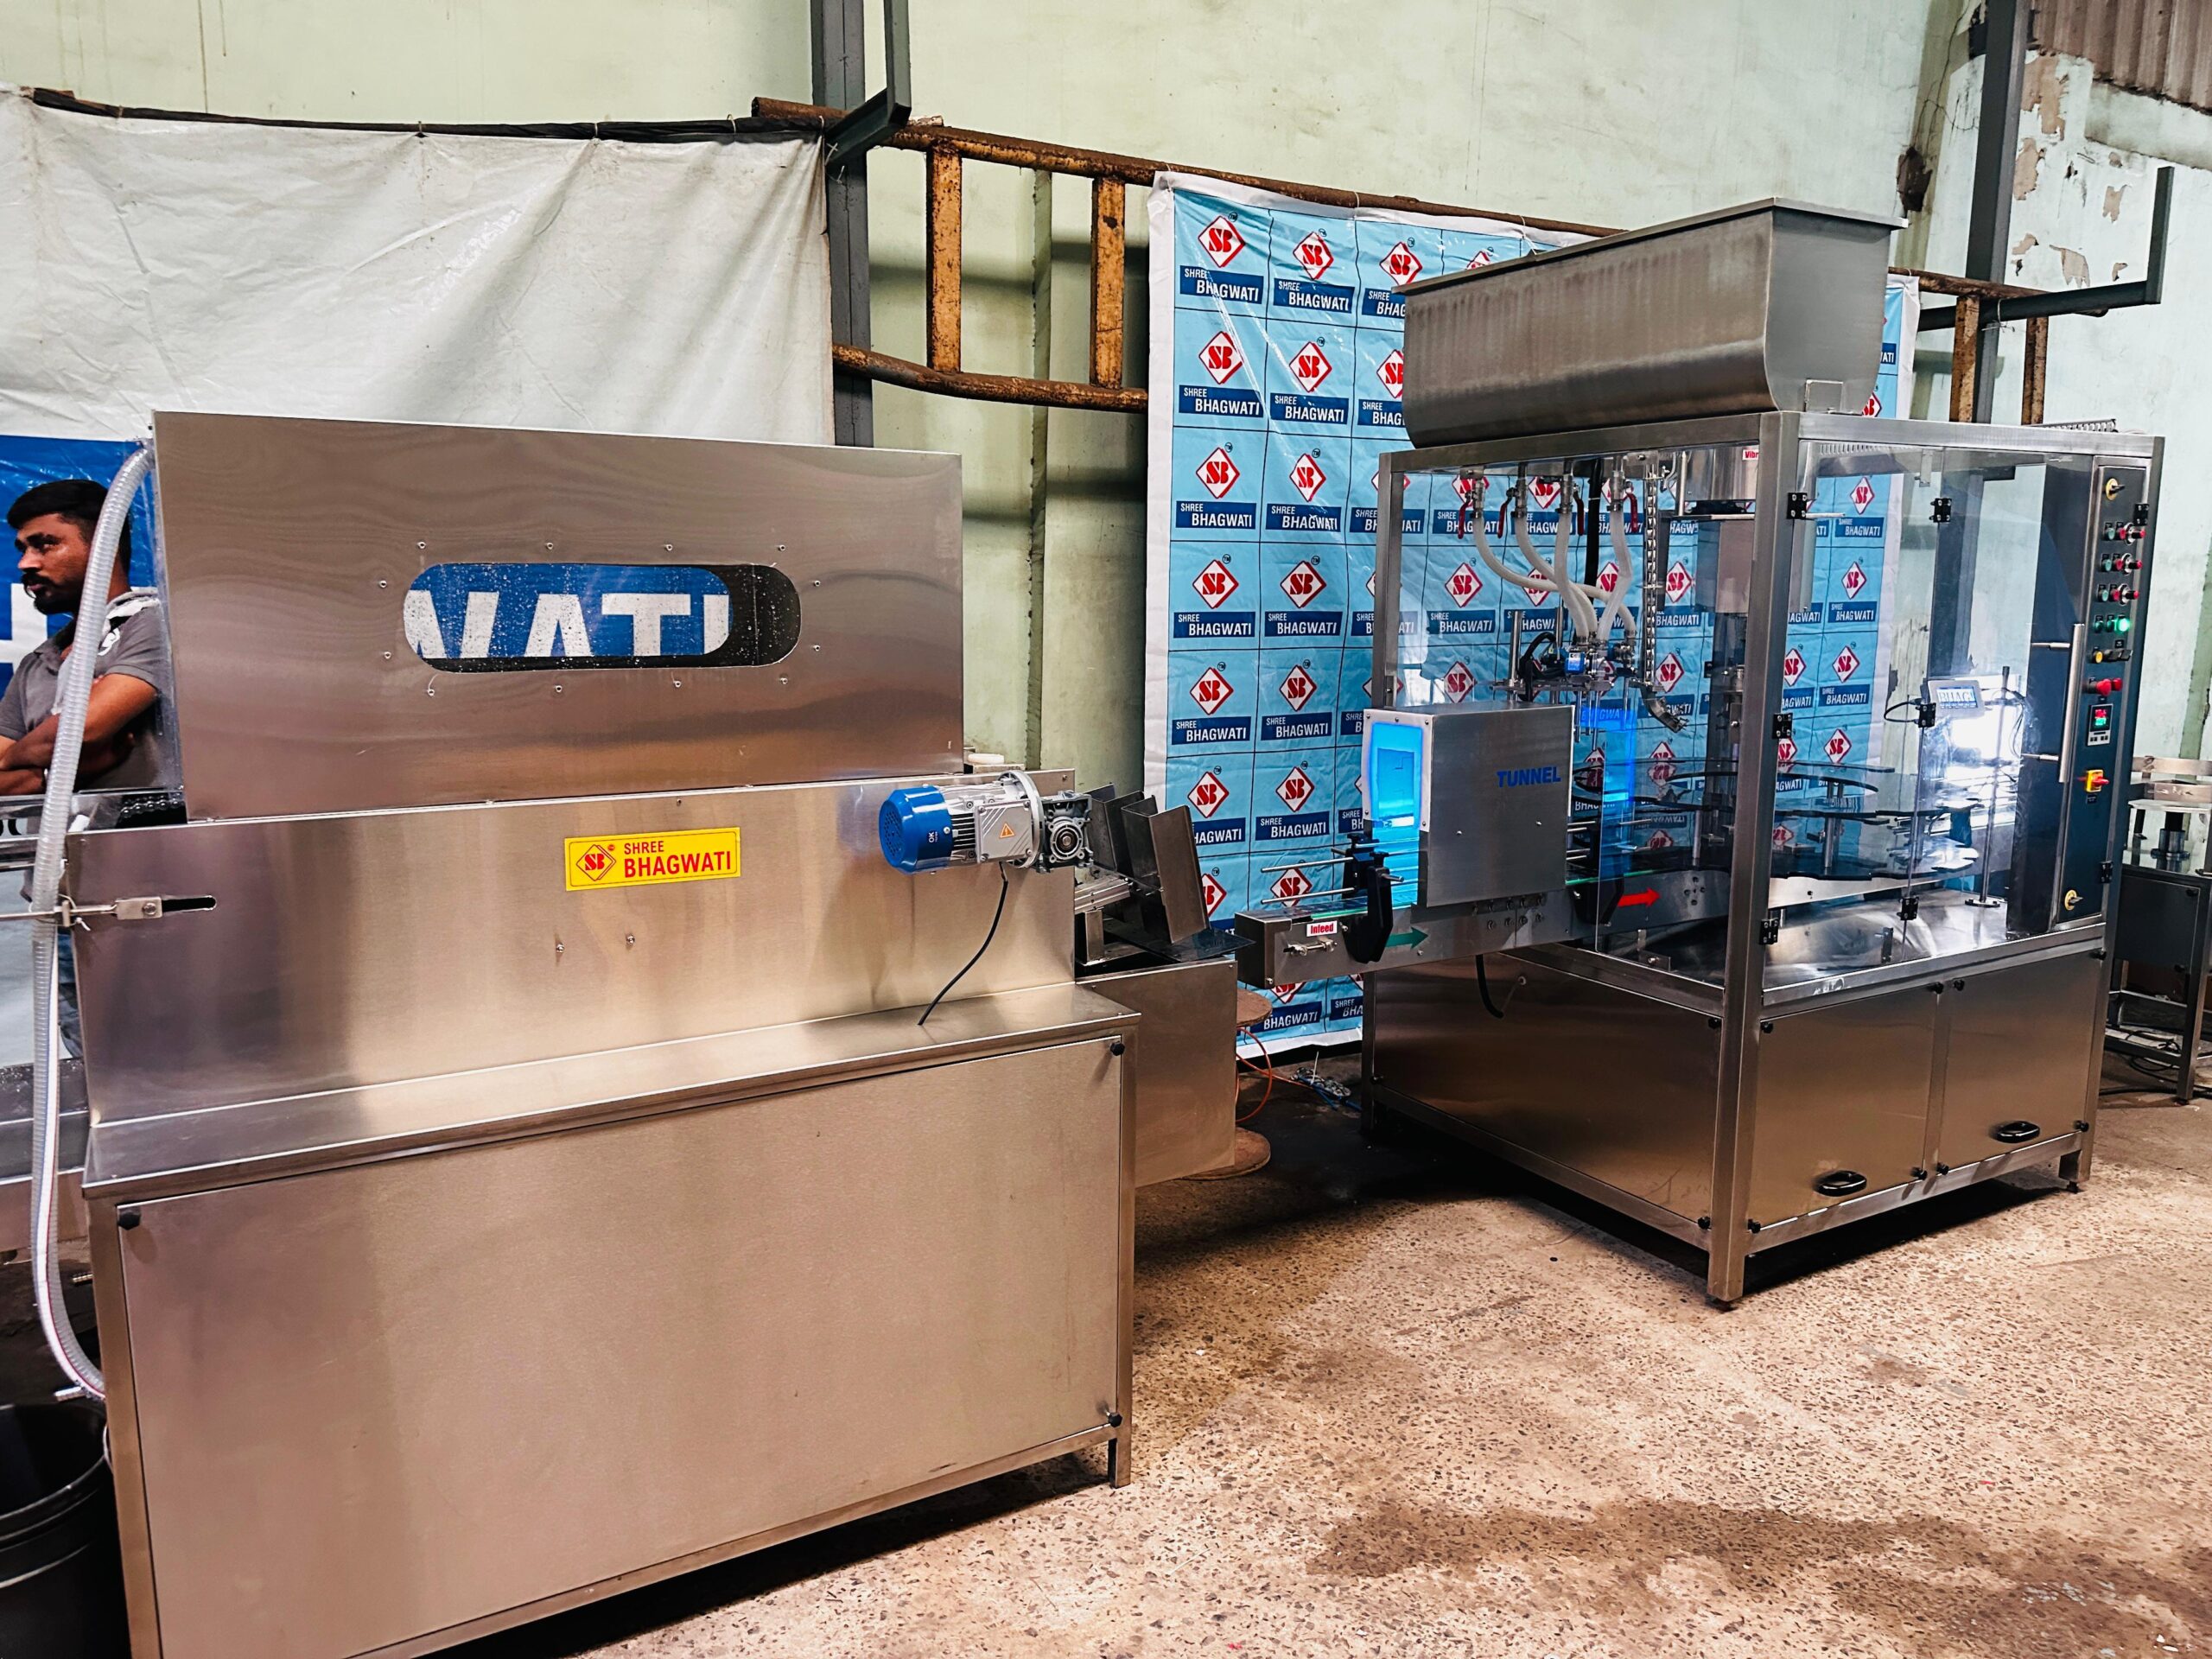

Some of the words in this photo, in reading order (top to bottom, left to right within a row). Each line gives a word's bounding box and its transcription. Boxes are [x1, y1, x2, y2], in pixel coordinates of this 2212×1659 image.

[1185, 268, 1208, 280] SHREE
[1196, 279, 1259, 302] BHAGWATI
[1278, 280, 1300, 291] SHREE
[1289, 291, 1349, 311] BHAGWATI
[1369, 290, 1389, 301] SHREE
[1184, 388, 1207, 397] SHREE
[1195, 398, 1260, 415] BHAGWATI
[1274, 396, 1297, 405] SHREE
[1363, 402, 1382, 410] SHREE
[1285, 406, 1344, 422] BHAGWATI
[1372, 412, 1405, 425] BHAG
[1180, 503, 1204, 512] SHREE
[1271, 505, 1295, 515] SHREE
[1192, 513, 1252, 527] BHAGWATI
[1282, 516, 1338, 530] BHAGWATI
[1845, 525, 1880, 537] BHAGWATI
[1178, 613, 1200, 622] SHREE
[1268, 613, 1287, 621] SHREE
[1656, 614, 1700, 626] BHAGWATI
[1836, 610, 1874, 621] BHAGWATI
[1189, 623, 1252, 636] BHAGWATI
[1277, 622, 1337, 634] BHAGWATI
[1440, 620, 1492, 632] BHAGWATI
[1826, 694, 1866, 705] BHAGWATI
[1176, 721, 1197, 729] SHREE
[1266, 716, 1286, 726] SHREE
[1186, 728, 1246, 742] BHAGWATI
[1275, 722, 1328, 738] BHAGWATI
[1497, 766, 1561, 788] TUNNEL
[1342, 810, 1360, 819] SHREE
[1261, 817, 1282, 827] SHREE
[928, 831, 935, 842] OK
[1271, 823, 1326, 838] BHAGWATI
[624, 841, 664, 855] SHREE
[624, 851, 731, 878] BHAGWATI
[1310, 923, 1334, 934] Infeed
[1335, 999, 1355, 1008] SHREE
[1264, 1011, 1318, 1029] BHAGWATI
